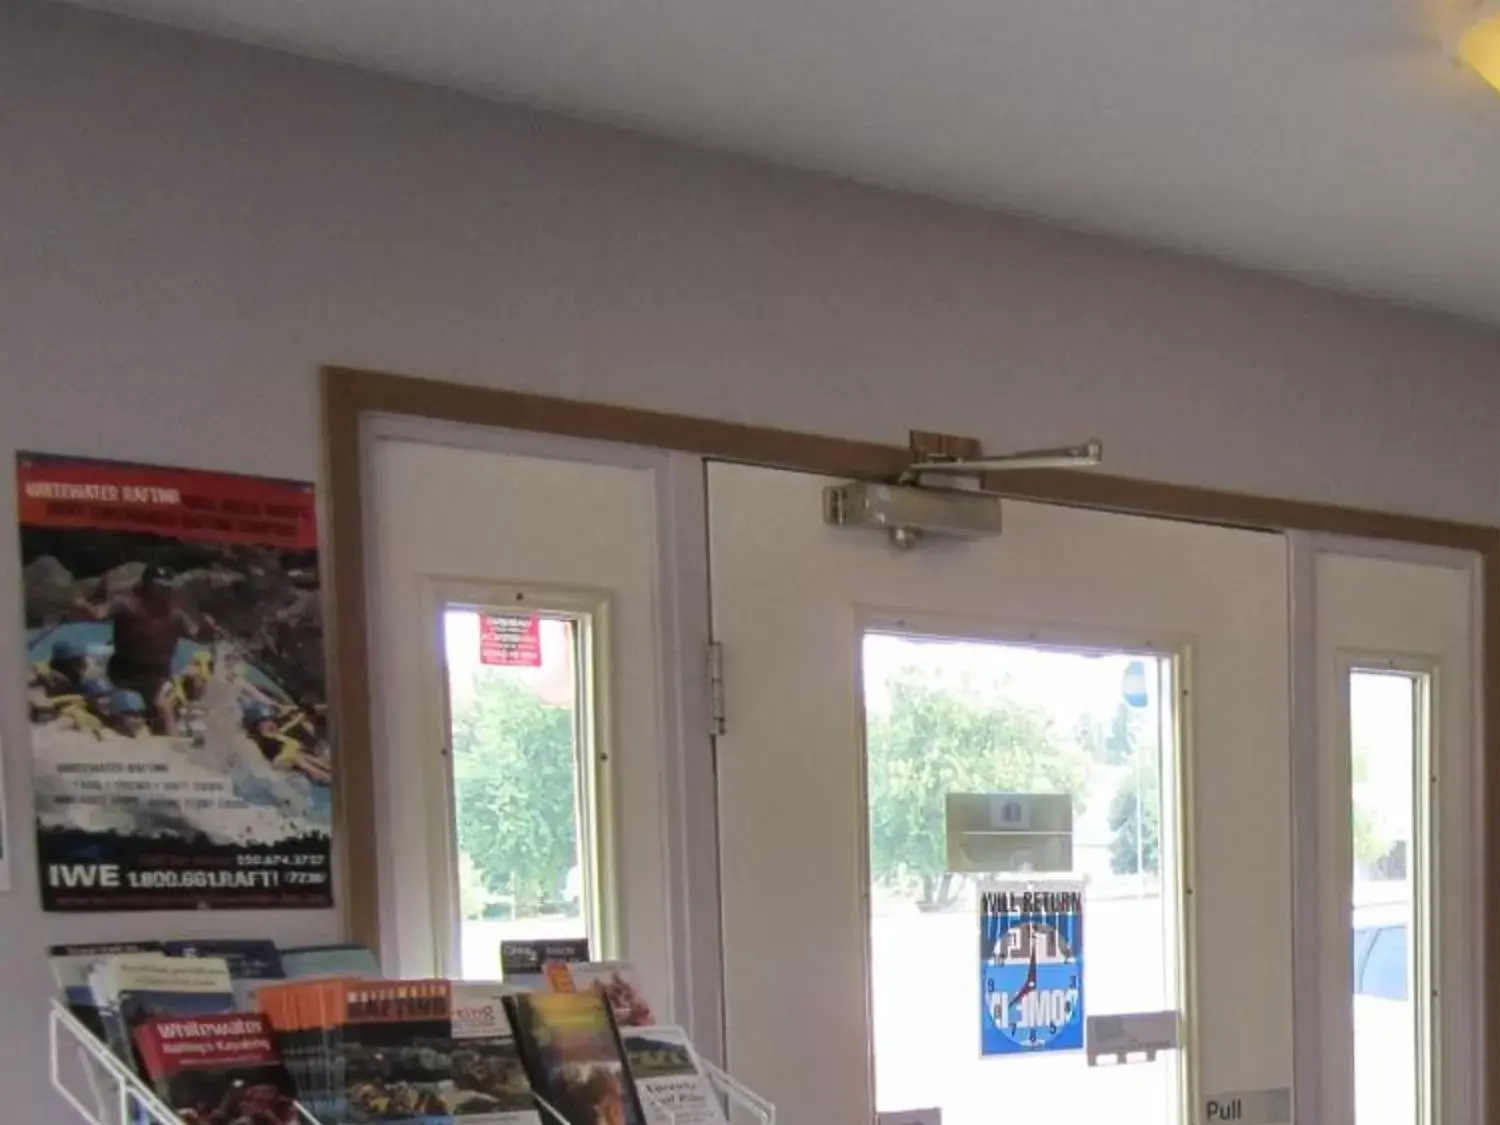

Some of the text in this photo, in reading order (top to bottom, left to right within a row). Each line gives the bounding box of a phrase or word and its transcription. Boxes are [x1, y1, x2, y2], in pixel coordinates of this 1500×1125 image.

[50, 864, 121, 887] IWE
[983, 891, 1082, 913] WILL RETURN
[1206, 1100, 1242, 1121] Pull
